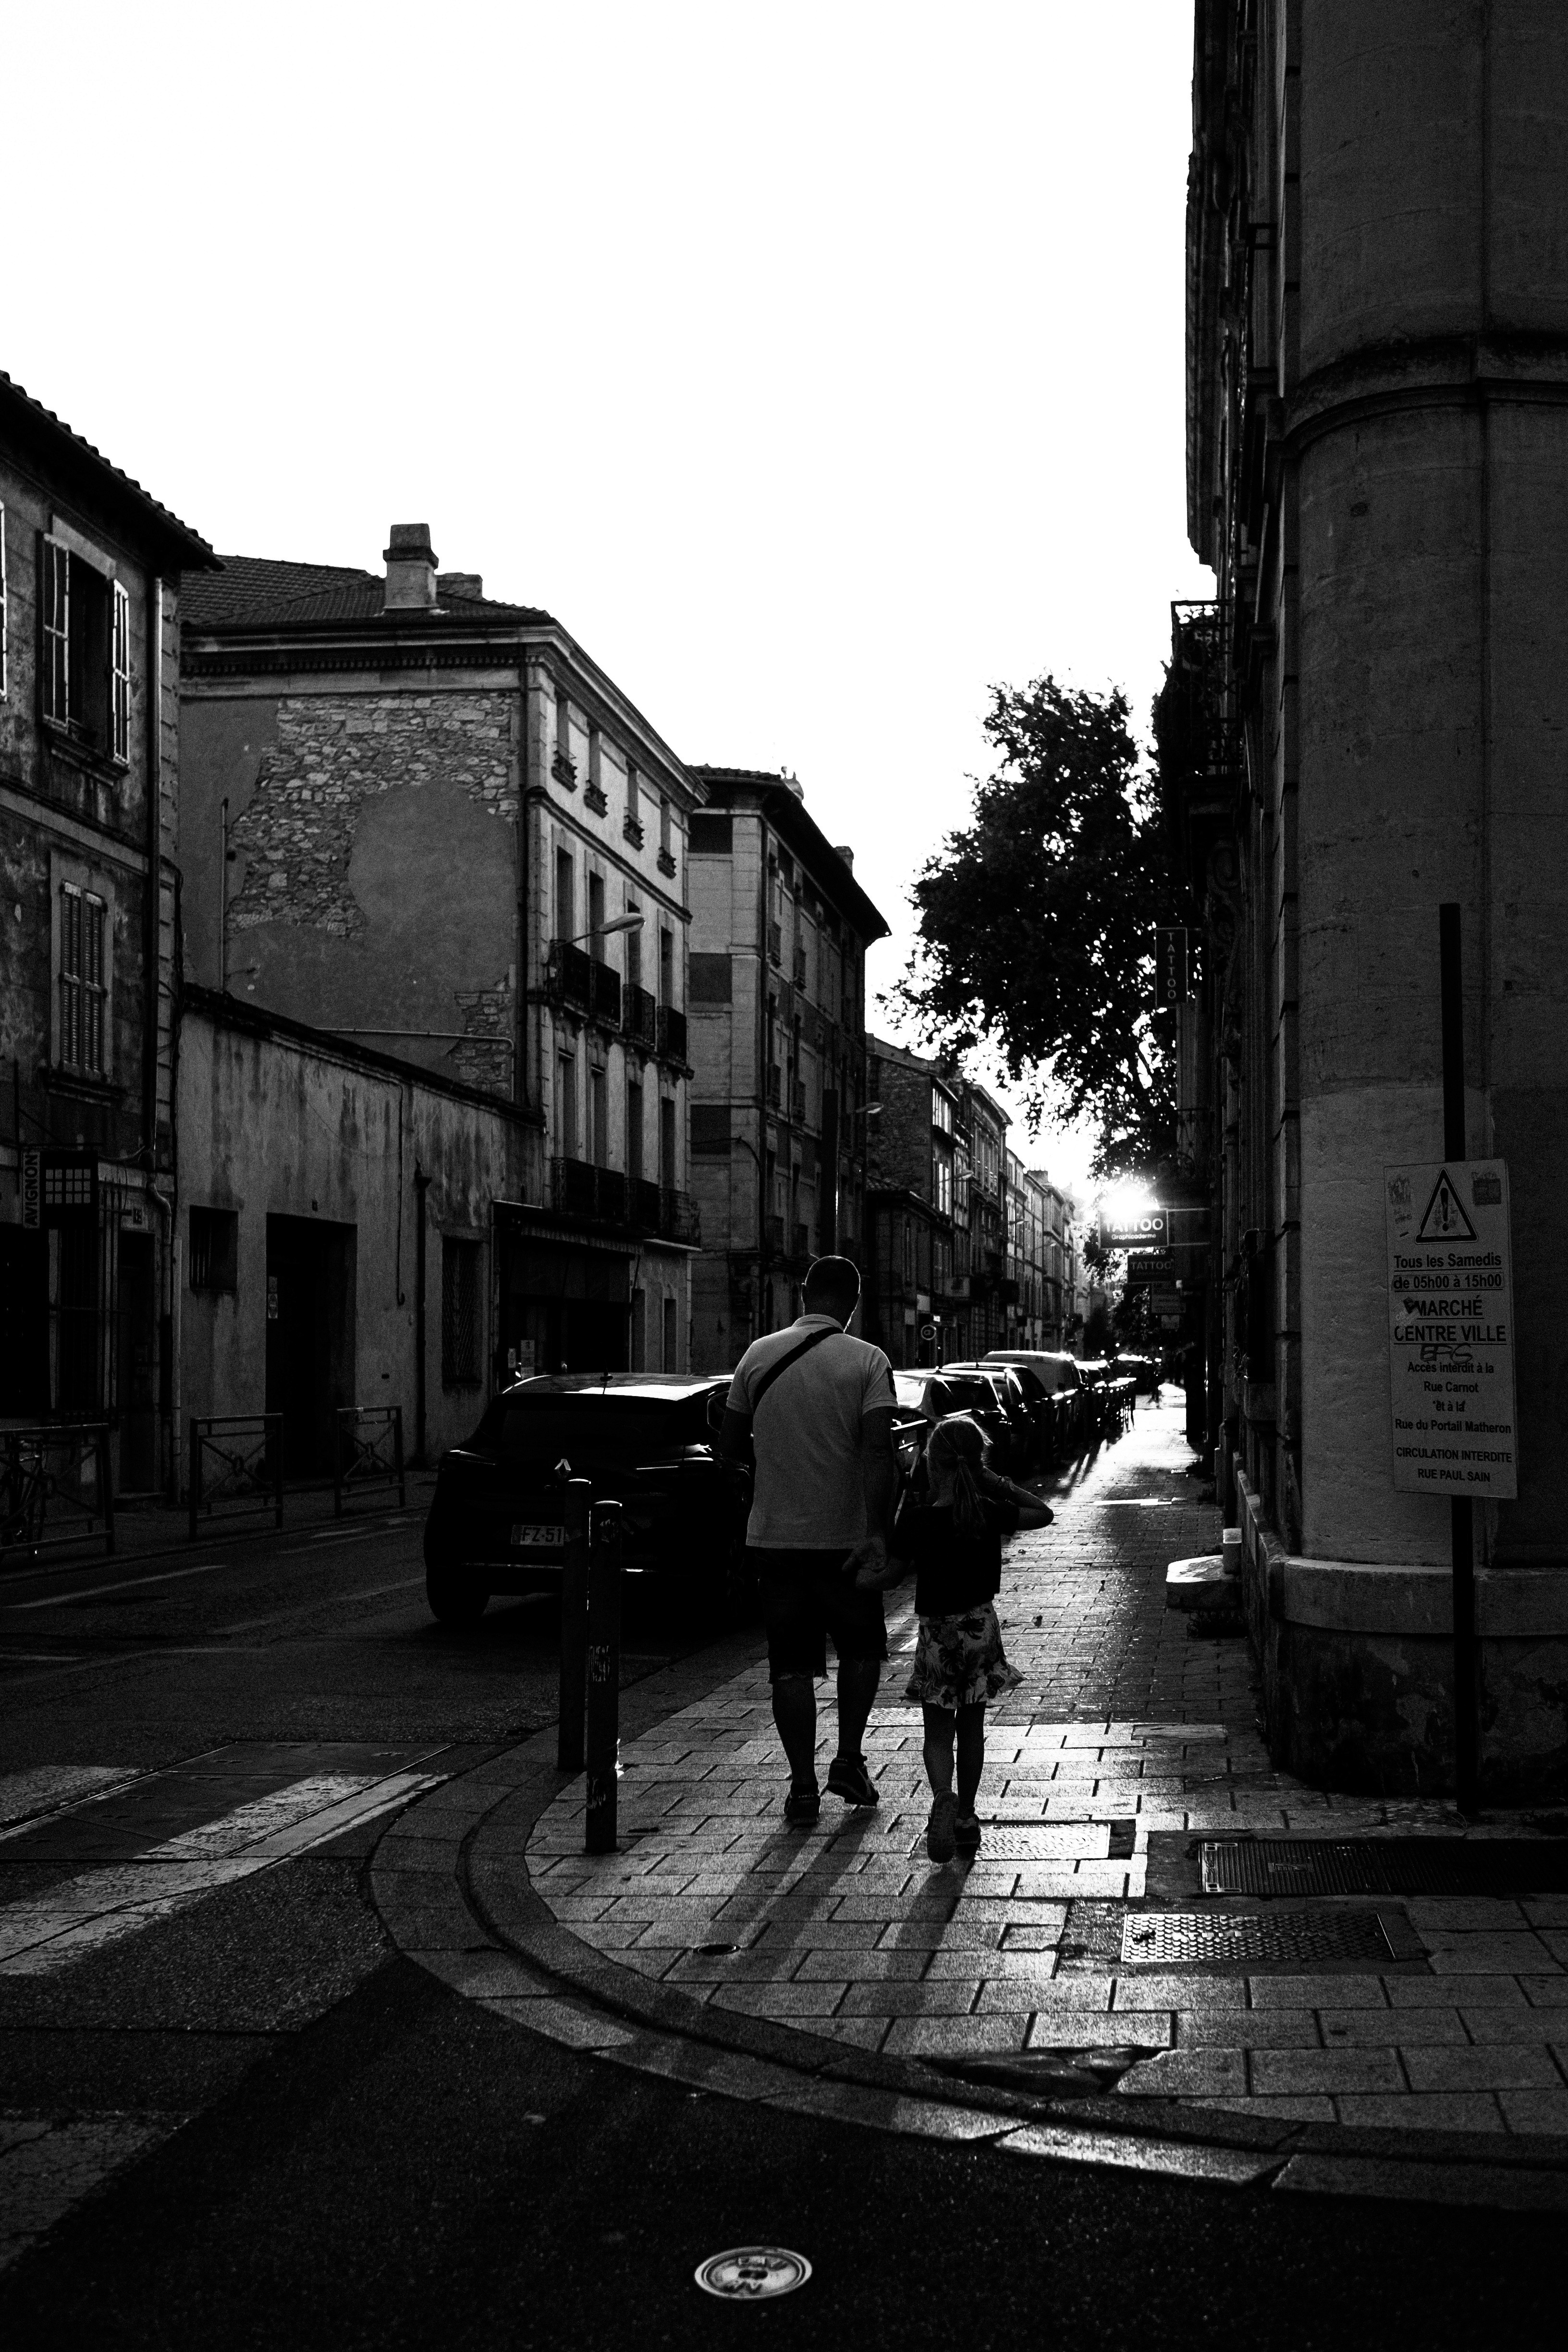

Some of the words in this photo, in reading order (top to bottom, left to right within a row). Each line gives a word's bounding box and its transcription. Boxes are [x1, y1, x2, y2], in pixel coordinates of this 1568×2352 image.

[1167, 932, 1176, 999] TATTOO
[24, 1154, 37, 1226] AVIGNON
[1106, 1218, 1164, 1232] TATTOO
[1394, 1255, 1422, 1268] Tous
[1427, 1254, 1444, 1267] les
[1448, 1252, 1502, 1267] Samedis
[1394, 1276, 1409, 1289] de
[1414, 1275, 1449, 1289] 05h00
[1453, 1274, 1460, 1288] à
[1465, 1274, 1502, 1287] 15h00
[1416, 1295, 1483, 1316] MARCHÉ
[1395, 1325, 1457, 1342] CENTRE
[1461, 1325, 1507, 1342] VILLE
[1408, 1361, 1437, 1372] Accès
[1440, 1361, 1474, 1373] interdit
[1477, 1362, 1483, 1373] à
[1486, 1362, 1494, 1373] la
[1424, 1381, 1443, 1392] Rue
[1446, 1382, 1479, 1393] Carnot
[1447, 1400, 1453, 1411] à
[1396, 1419, 1413, 1430] Rue
[1416, 1420, 1428, 1430] du
[1431, 1420, 1462, 1432] Portail
[1465, 1421, 1511, 1433] Matheron
[1396, 1447, 1459, 1460] CIRCULATION
[1461, 1450, 1512, 1463] INTERDITE
[1418, 1469, 1437, 1479] RUE
[1440, 1469, 1465, 1481] PAUL
[1468, 1471, 1491, 1482] SAIN
